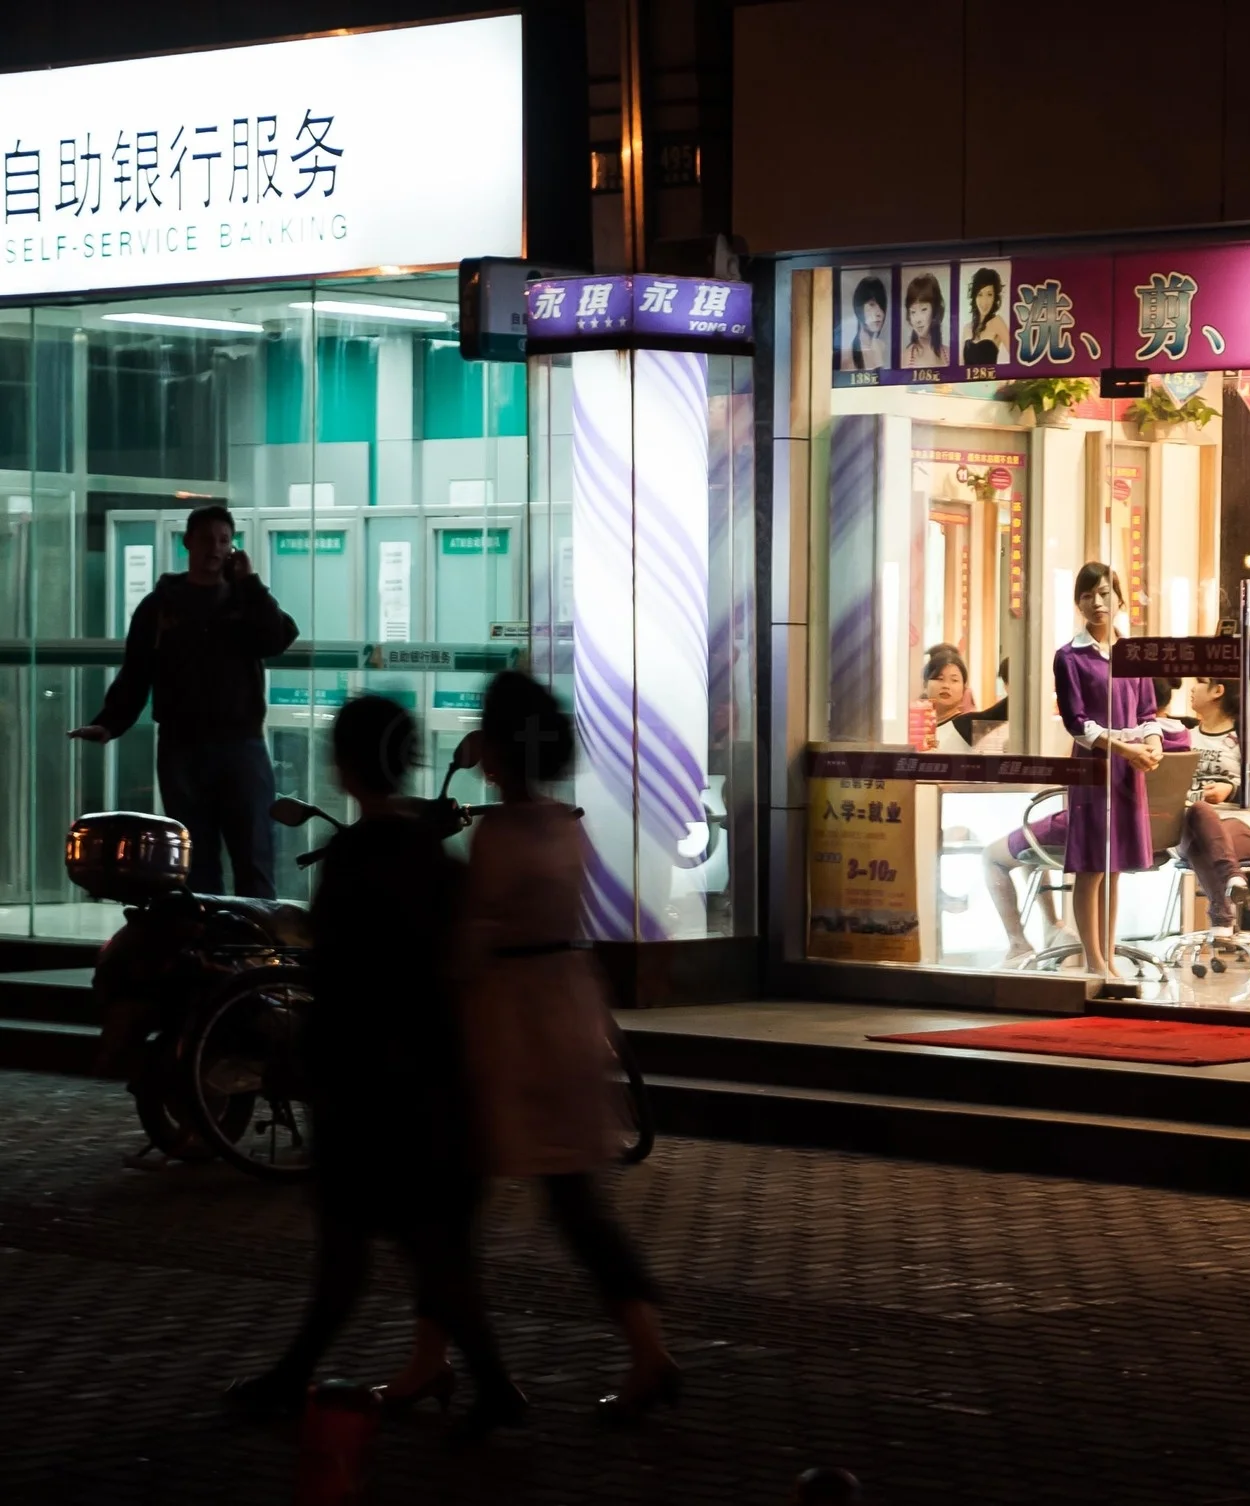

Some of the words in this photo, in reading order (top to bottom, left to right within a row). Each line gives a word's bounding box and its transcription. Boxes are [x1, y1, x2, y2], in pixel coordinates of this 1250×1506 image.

[3, 108, 345, 224] 自助银行服务
[4, 225, 199, 264] SELF-SERVICE
[219, 213, 349, 249] BANKING
[533, 283, 614, 320] 永琪
[638, 281, 731, 317] 永琪
[688, 320, 727, 333] YONG
[731, 324, 746, 334] QI
[965, 366, 996, 381] 128元
[389, 650, 451, 665] 自助银行服务
[1125, 643, 1196, 662] 欢迎光临
